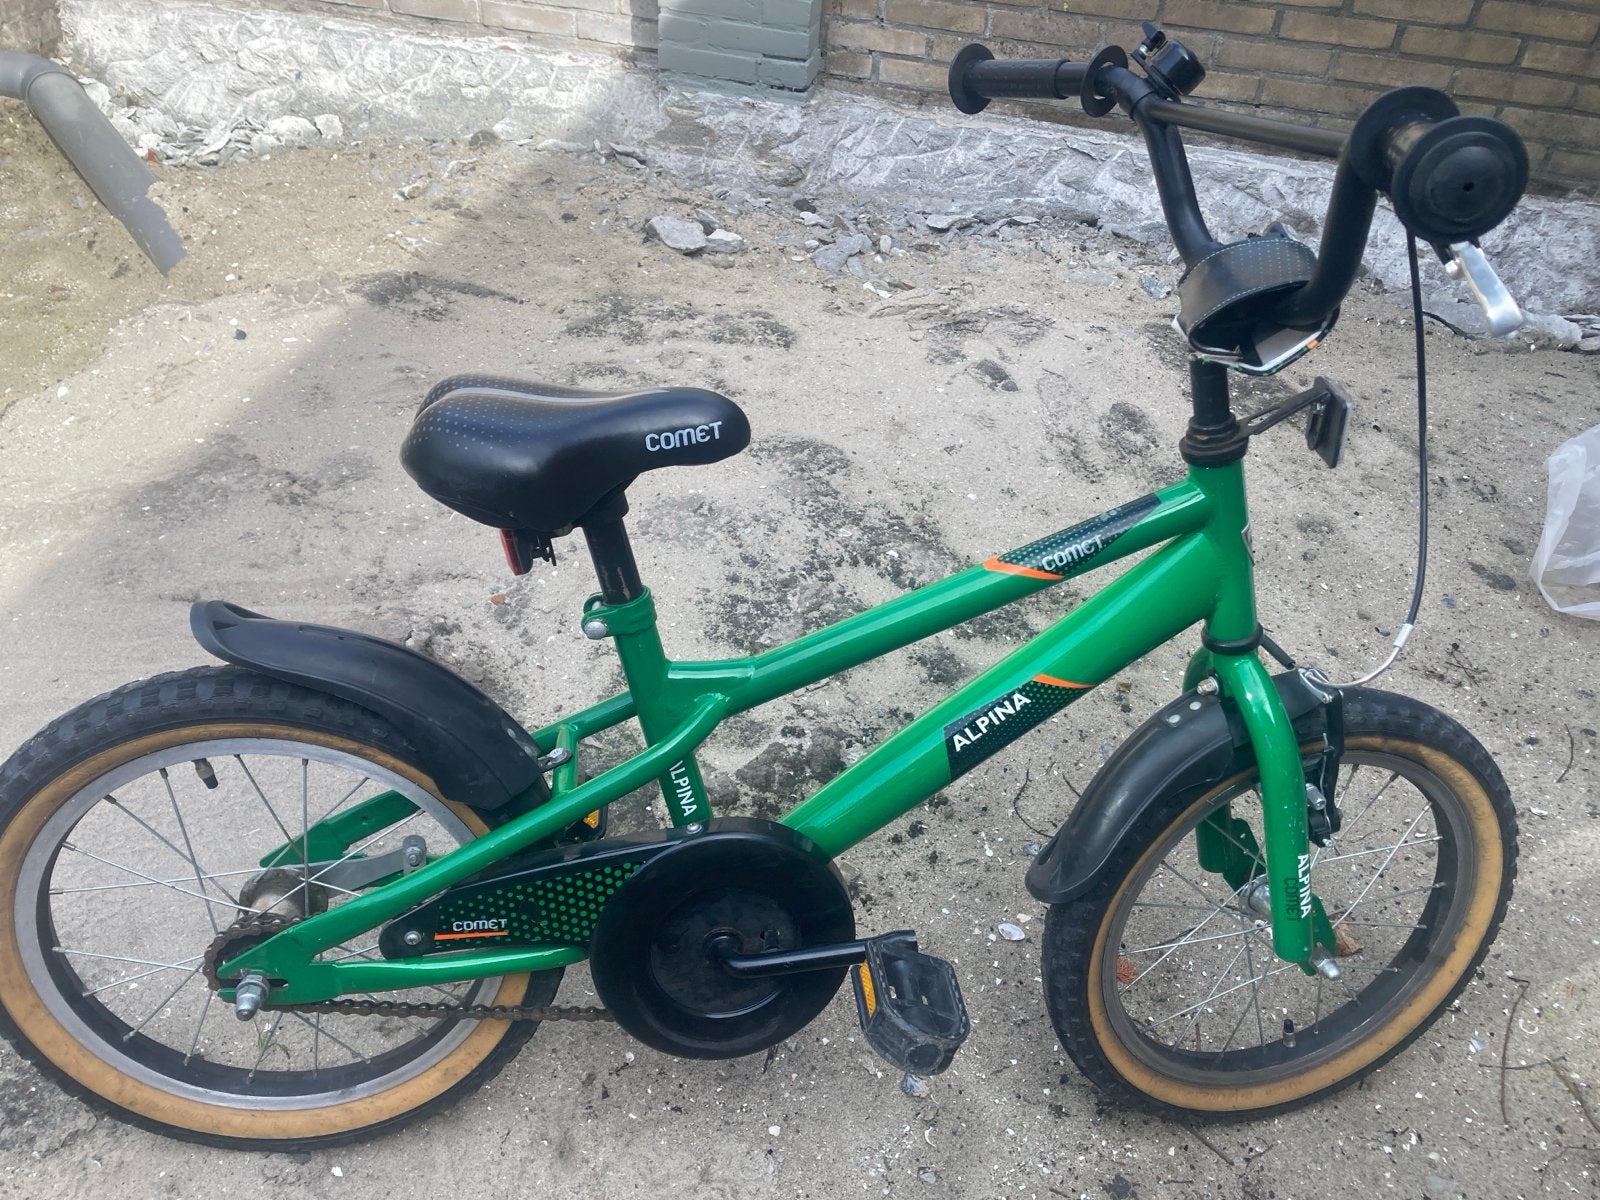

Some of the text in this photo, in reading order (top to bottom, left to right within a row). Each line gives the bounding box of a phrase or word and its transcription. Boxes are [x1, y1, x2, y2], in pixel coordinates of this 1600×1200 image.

[645, 421, 722, 452] COMET
[1041, 534, 1104, 571] COMET
[952, 692, 1032, 753] ALPINA
[1297, 853, 1312, 919] ALPINA
[452, 919, 508, 932] COMET
